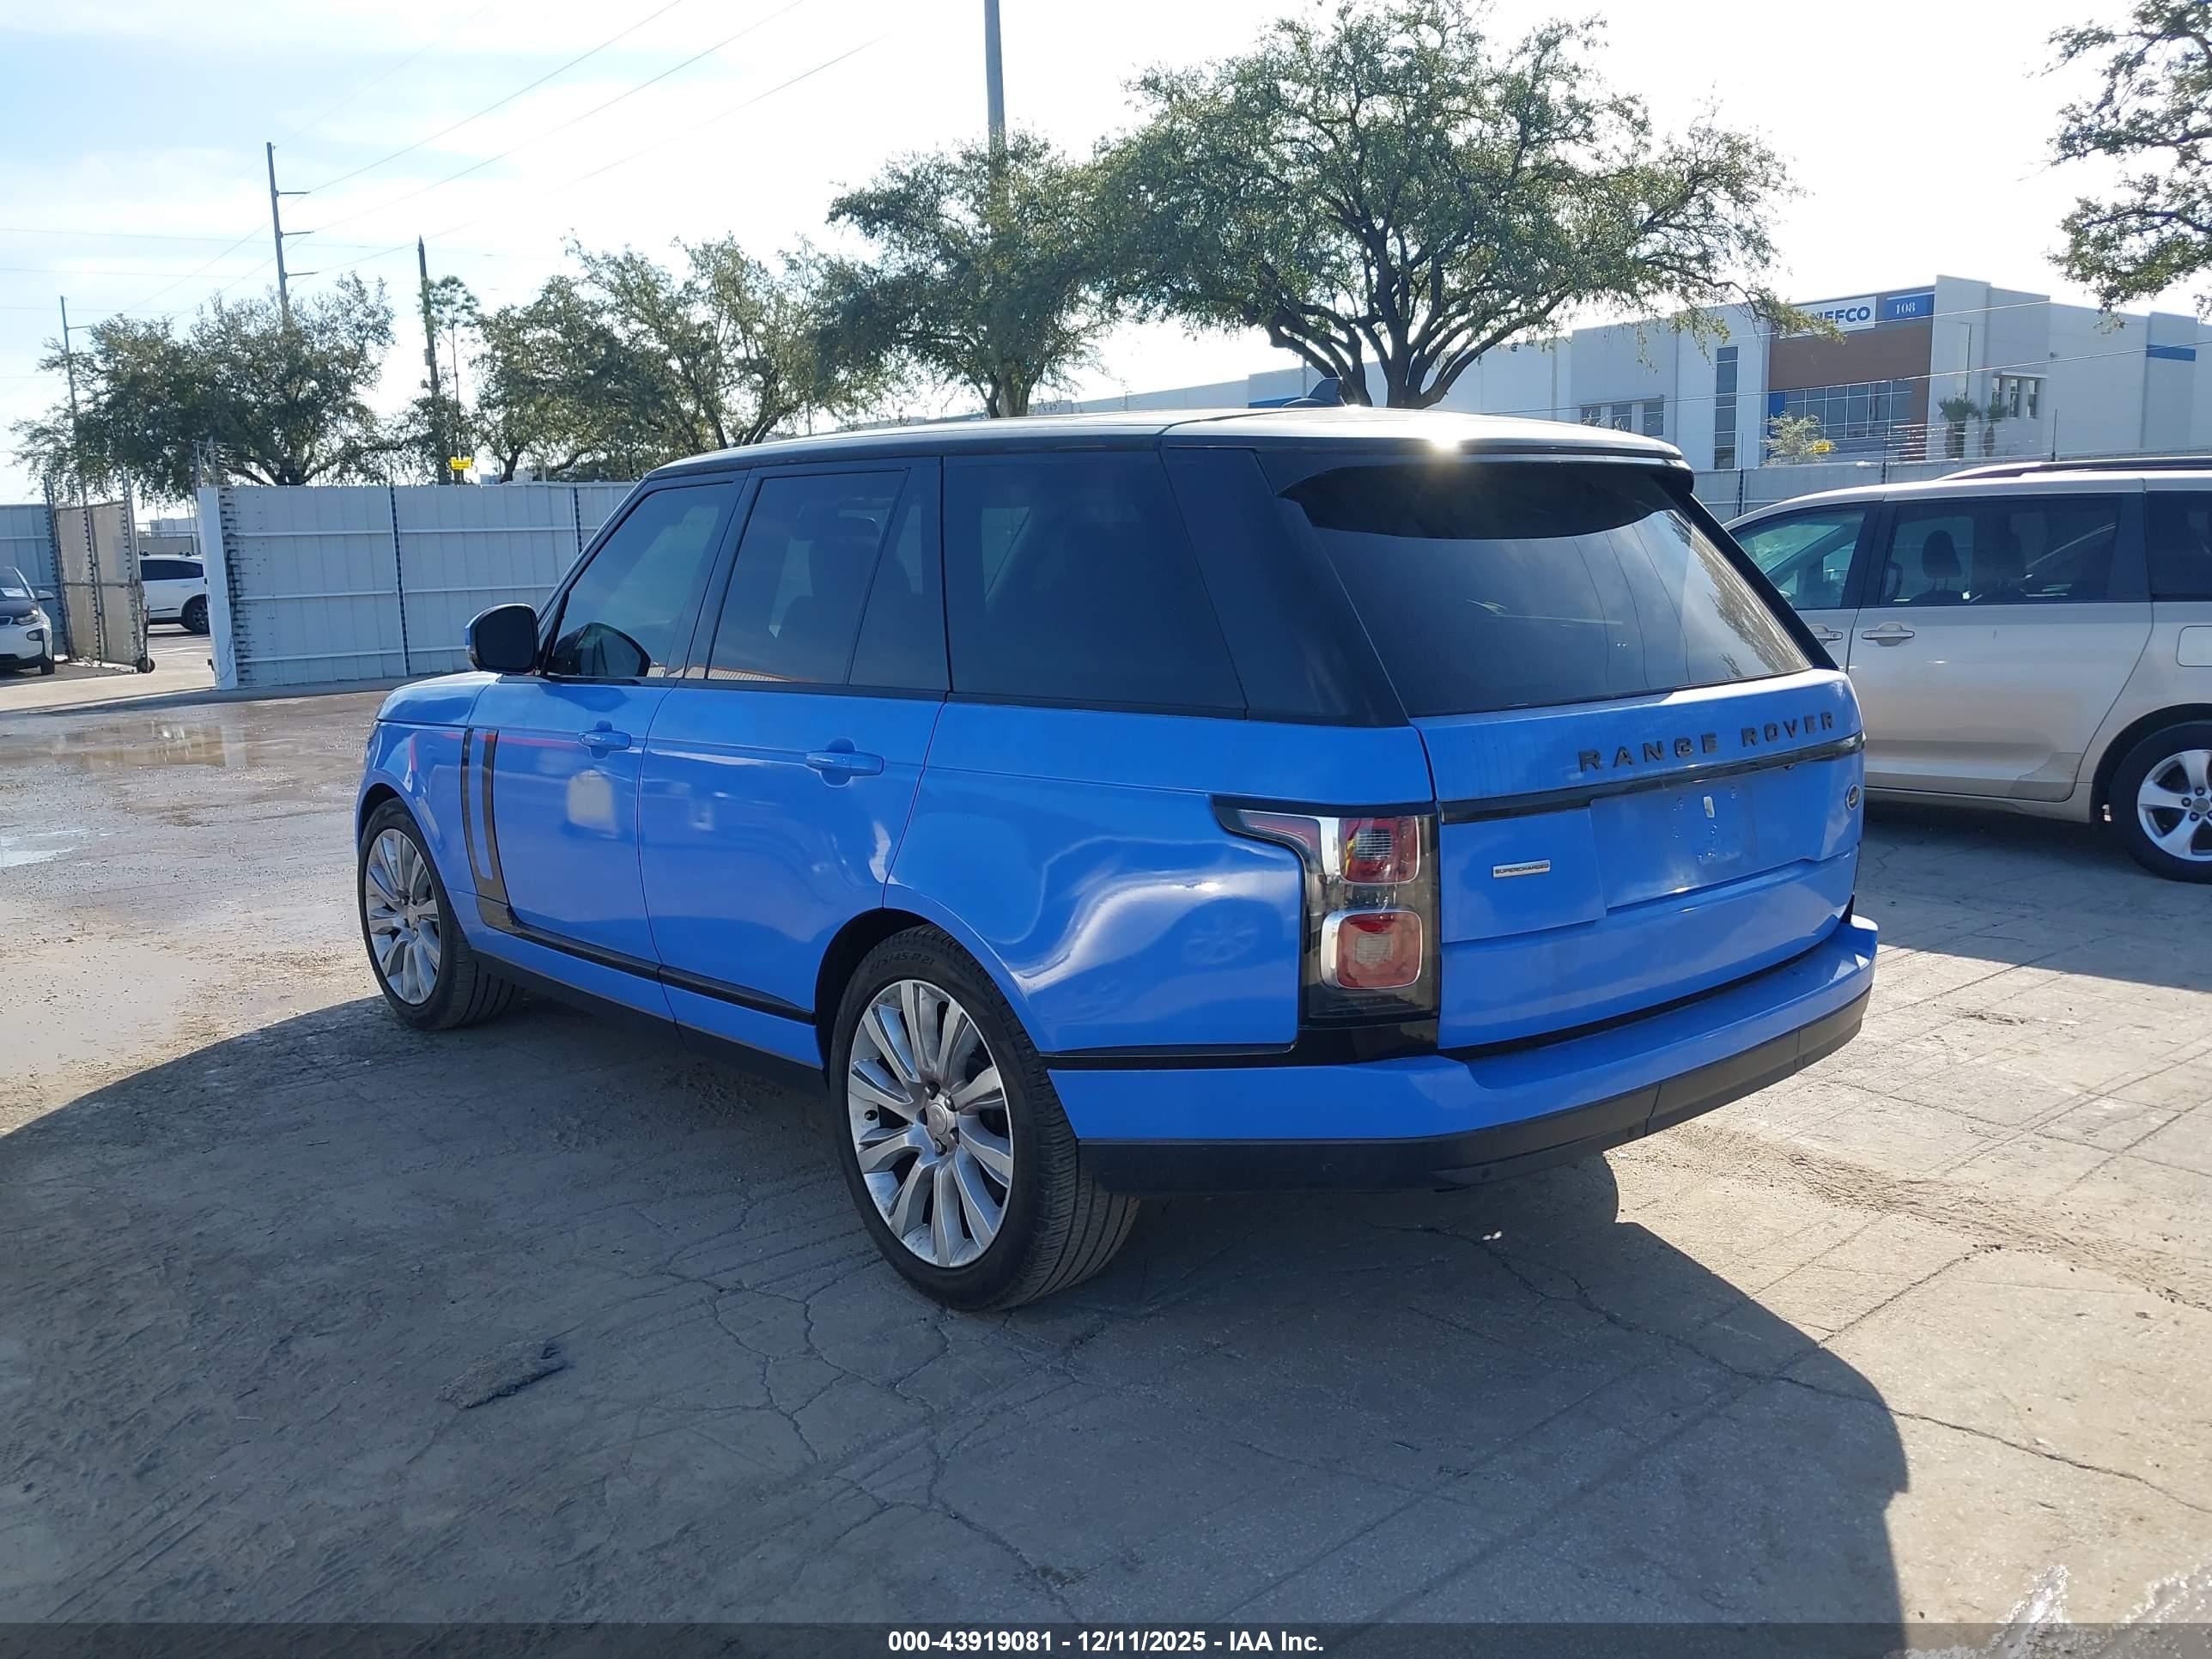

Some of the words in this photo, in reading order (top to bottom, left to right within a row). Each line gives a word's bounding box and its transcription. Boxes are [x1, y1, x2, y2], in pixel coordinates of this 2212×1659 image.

[1894, 301, 1917, 315] 108
[1577, 732, 1718, 773] RANGE
[1741, 711, 1834, 748] ROVER
[1494, 863, 1549, 875] SUPERCHARGED
